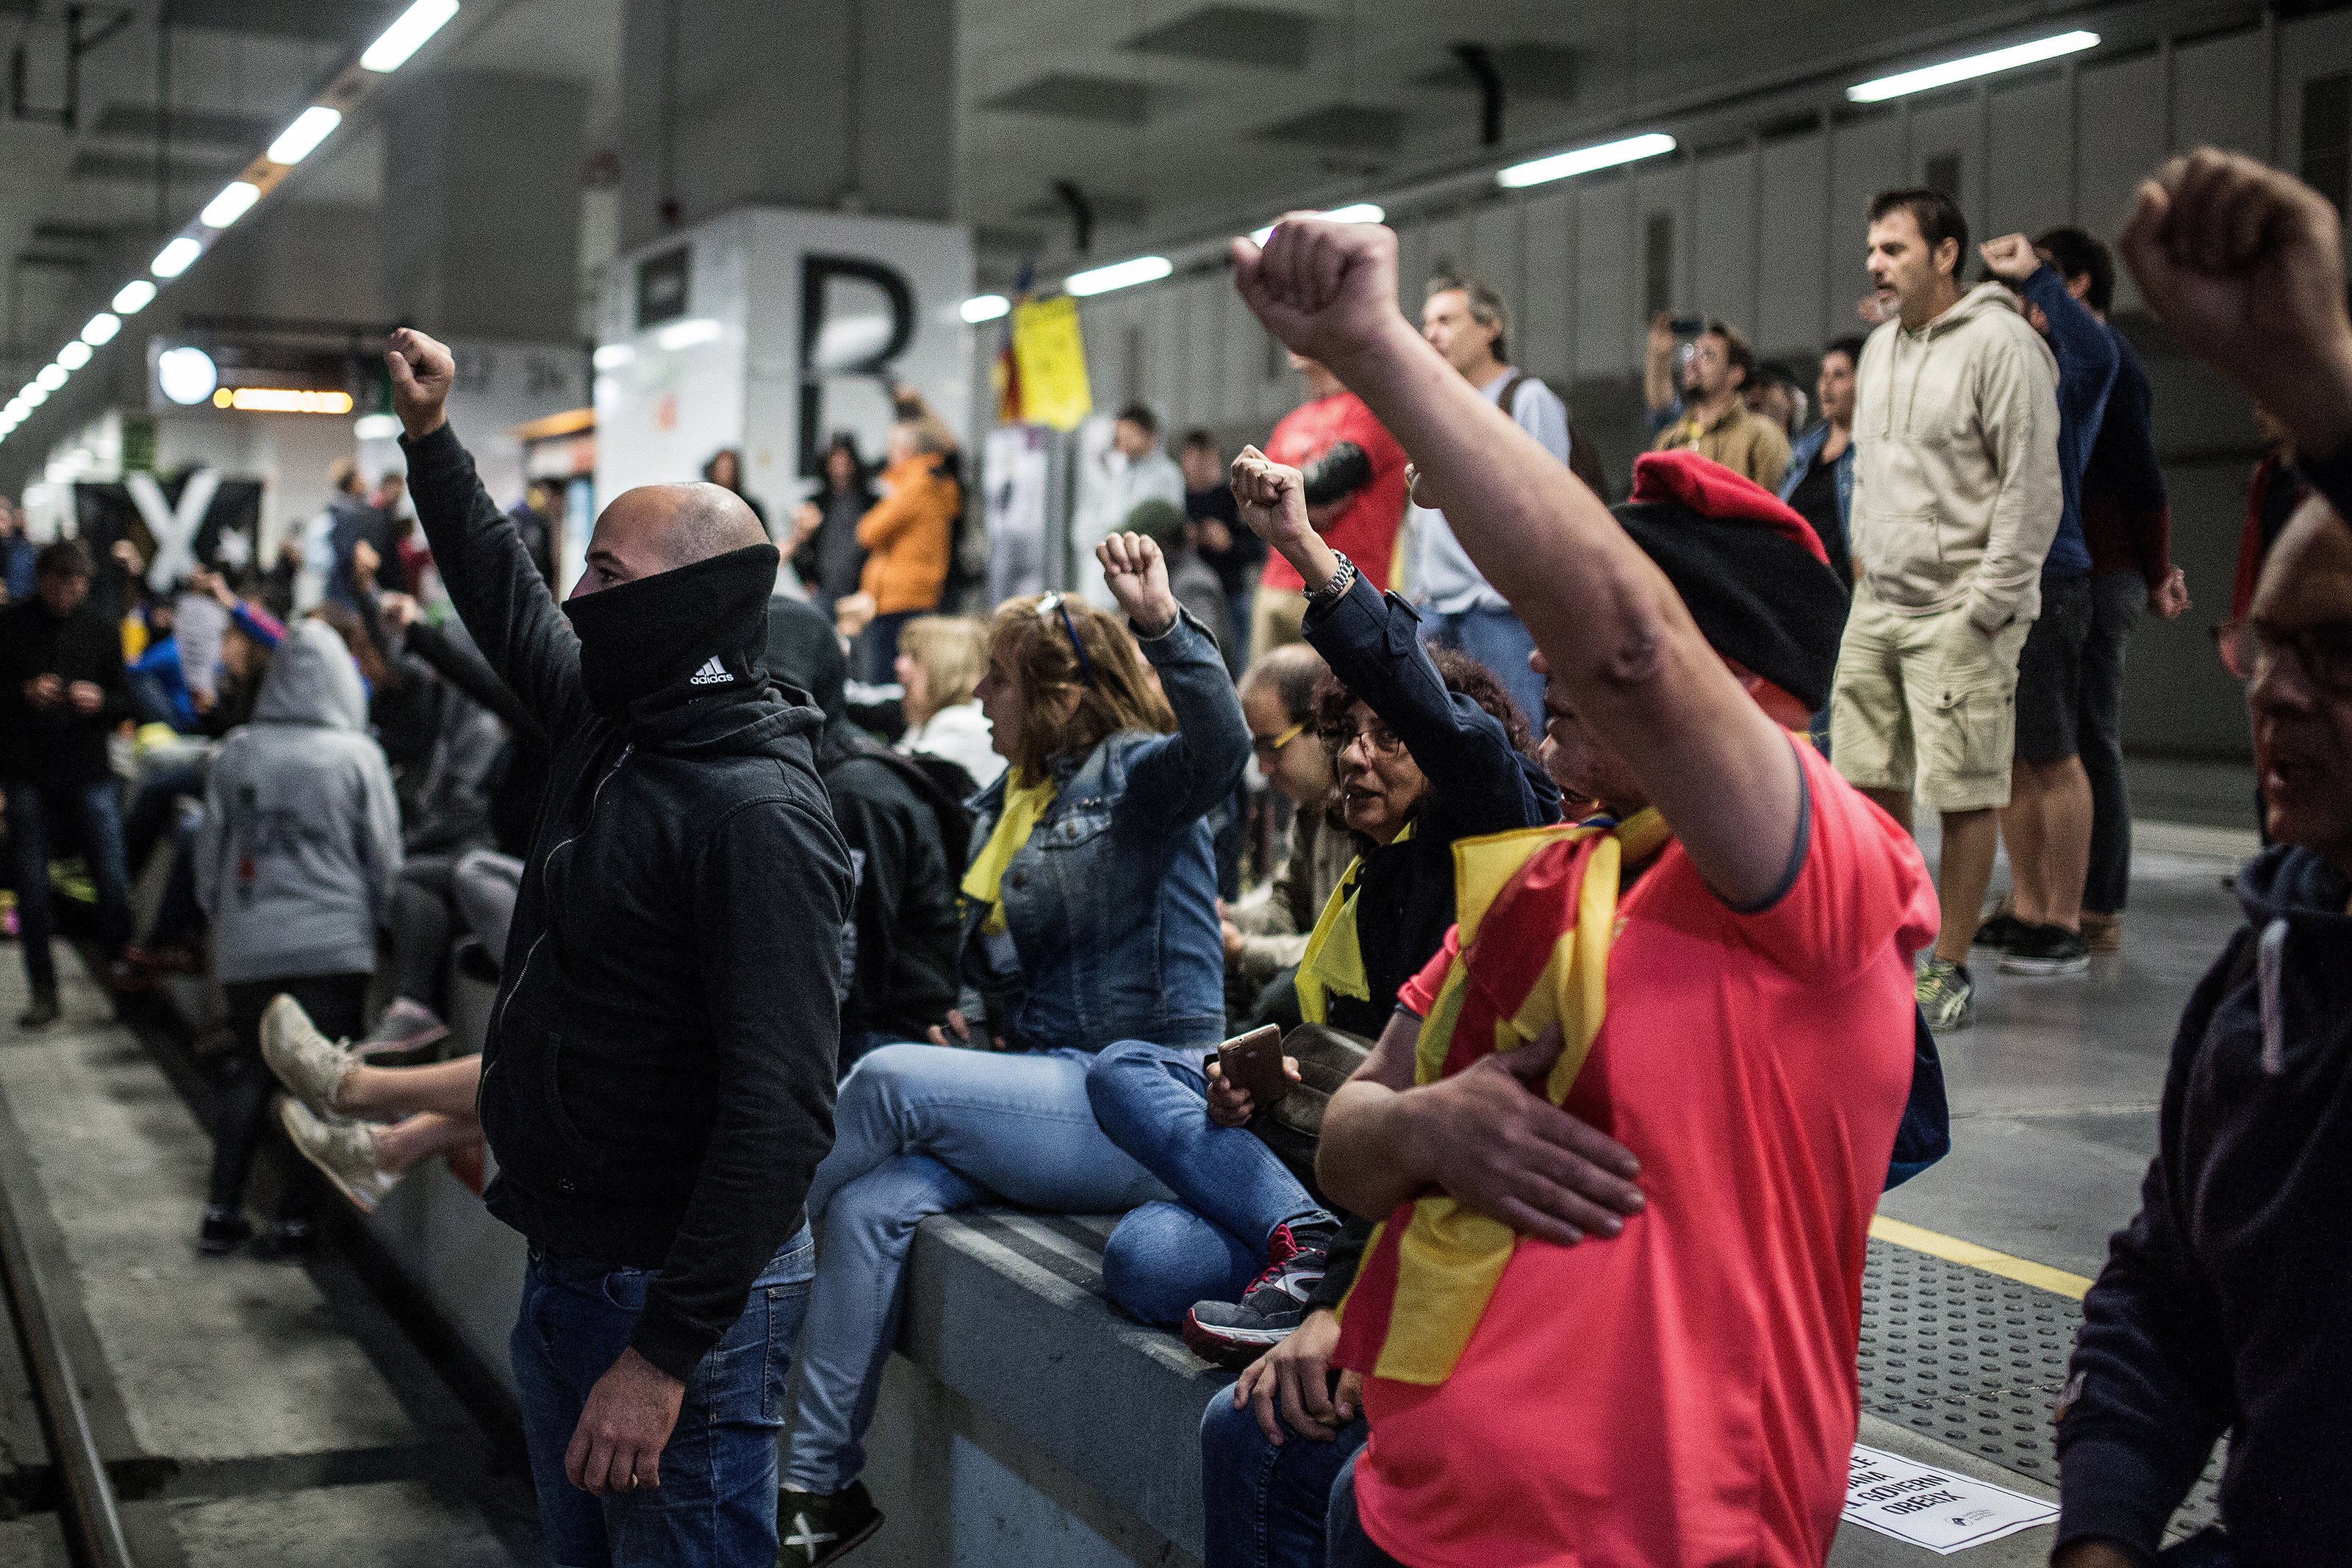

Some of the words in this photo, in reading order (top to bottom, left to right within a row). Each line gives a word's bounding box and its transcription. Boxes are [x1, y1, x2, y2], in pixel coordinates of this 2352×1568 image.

[800, 253, 917, 478] R
[690, 674, 734, 684] adidas
[1857, 1474, 1951, 1502] GOVERN
